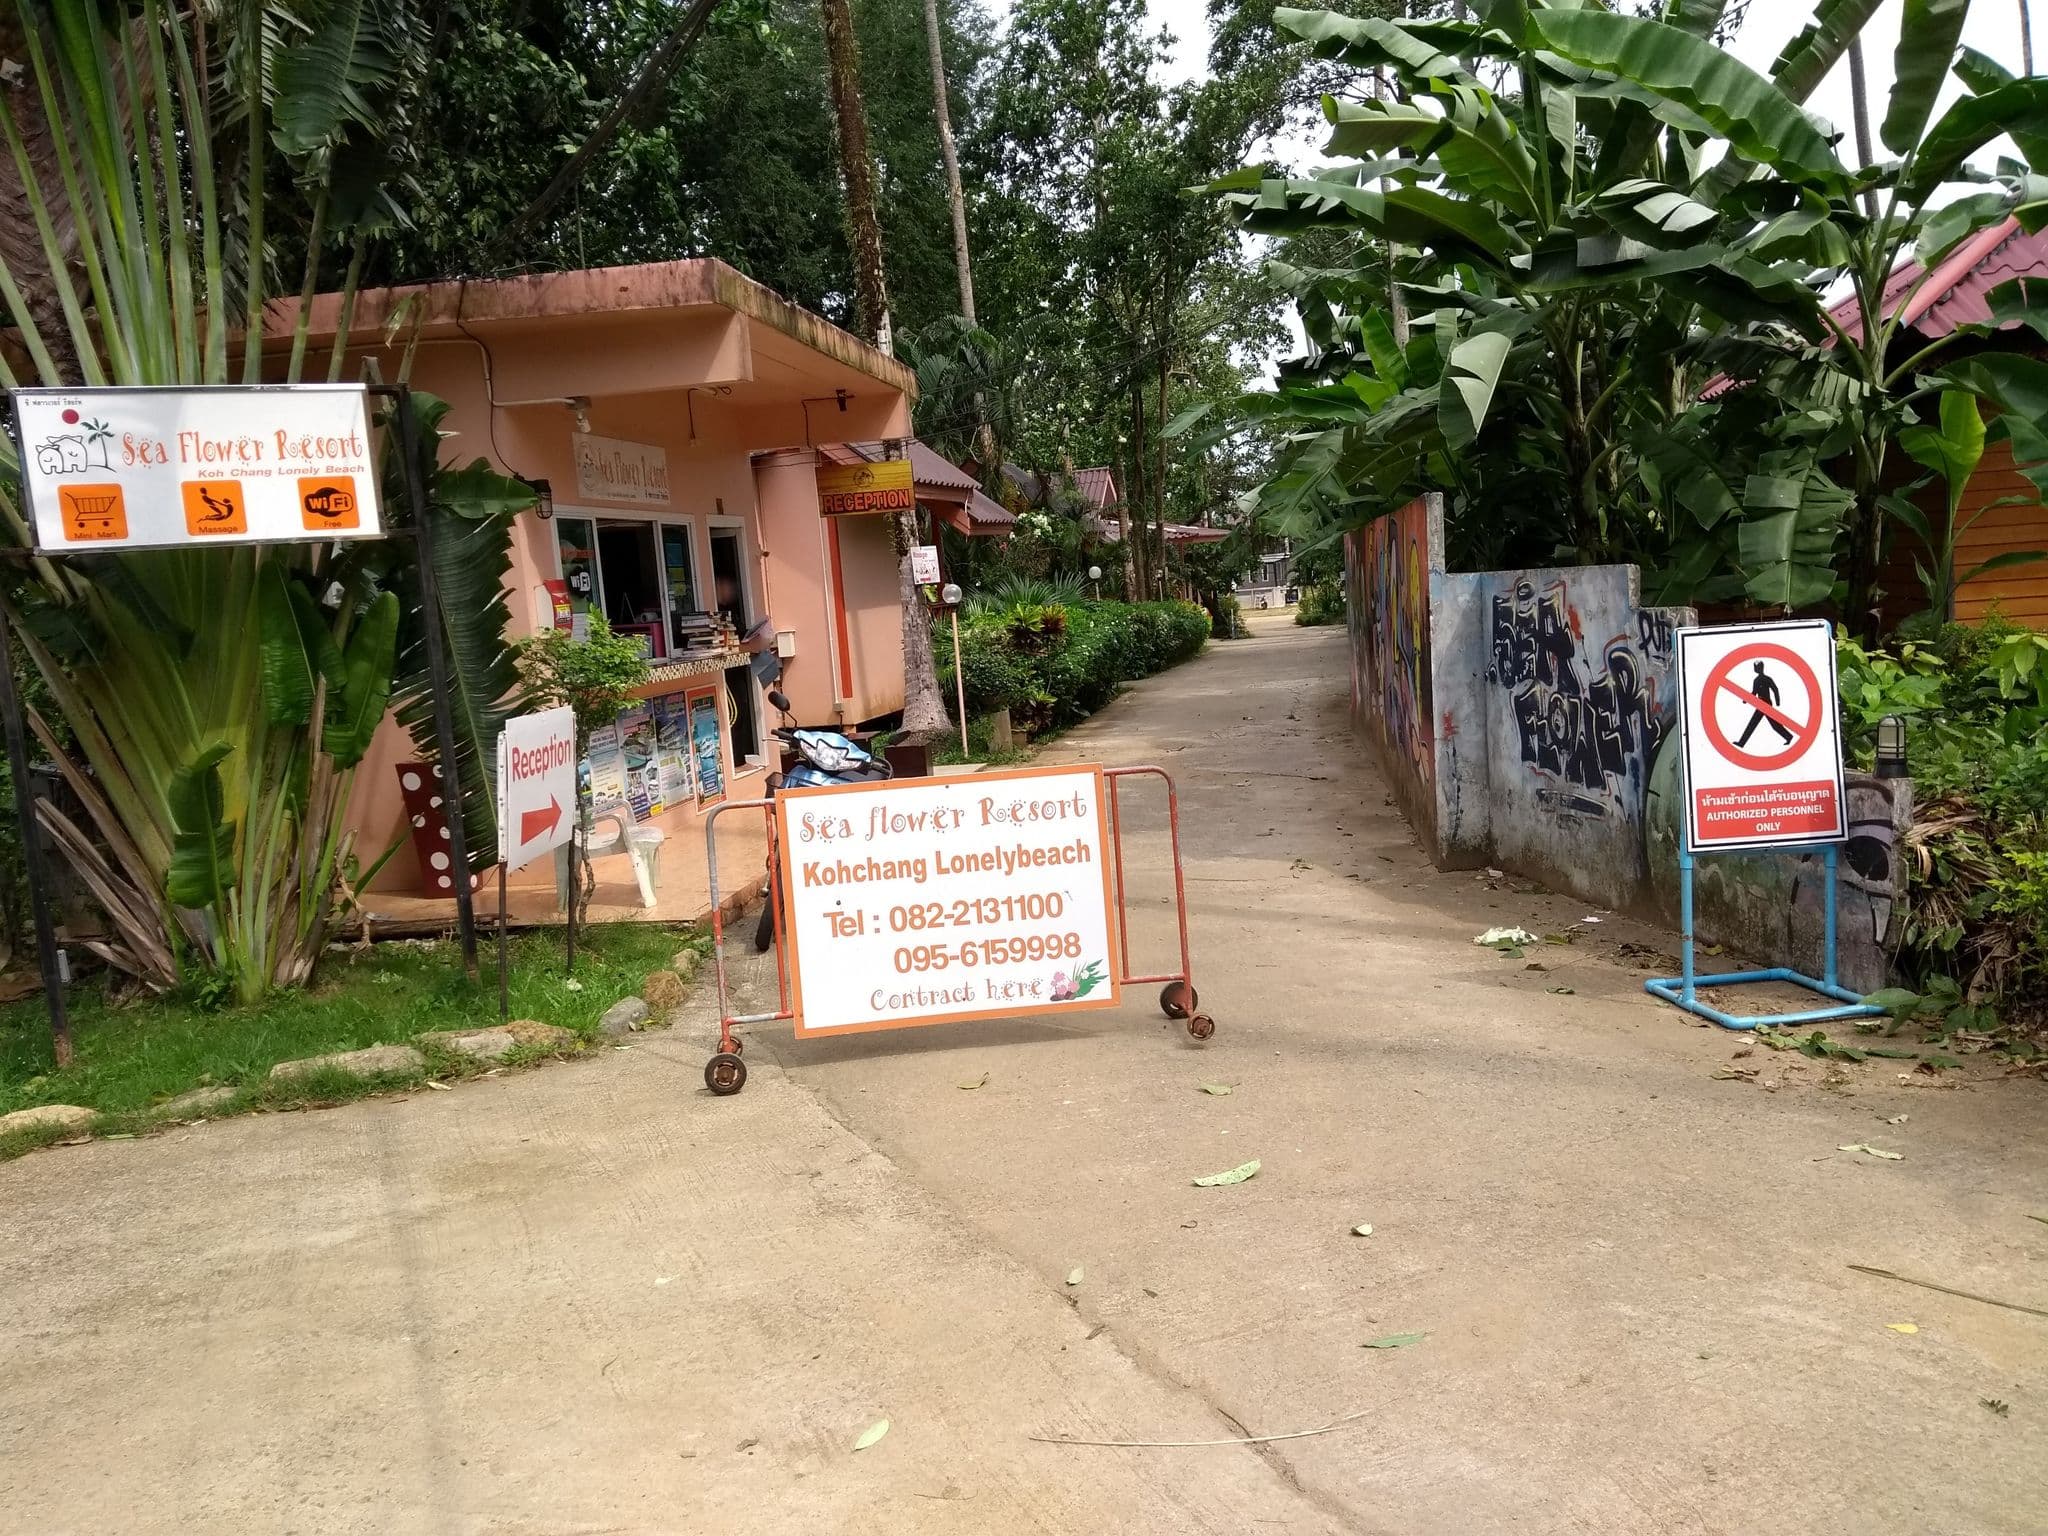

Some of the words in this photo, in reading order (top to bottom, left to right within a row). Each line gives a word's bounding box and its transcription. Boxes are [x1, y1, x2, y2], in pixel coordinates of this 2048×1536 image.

[122, 431, 169, 468] Sea
[177, 430, 264, 466] Flower
[274, 428, 363, 464] Resort
[198, 469, 224, 478] Koh
[230, 468, 272, 479] Chang
[278, 466, 320, 475] Lonely
[325, 464, 365, 474] Beach
[823, 488, 910, 513] RECEPTION
[198, 525, 238, 533] Massage
[323, 520, 343, 528] Free
[511, 733, 571, 783] Reception
[800, 811, 855, 843] Sea
[979, 790, 1088, 826] Resort
[1706, 808, 1768, 822] AUTHORIZED
[1770, 804, 1825, 817] PERSONNEL
[1756, 822, 1781, 832] ONLY
[802, 857, 928, 887] Kohchang
[935, 838, 1091, 876] Lonelybeach
[889, 892, 1064, 933] 082-2131100
[894, 932, 1083, 974] 095-6159998
[870, 981, 976, 1011] Contract
[986, 978, 1043, 1002] here
